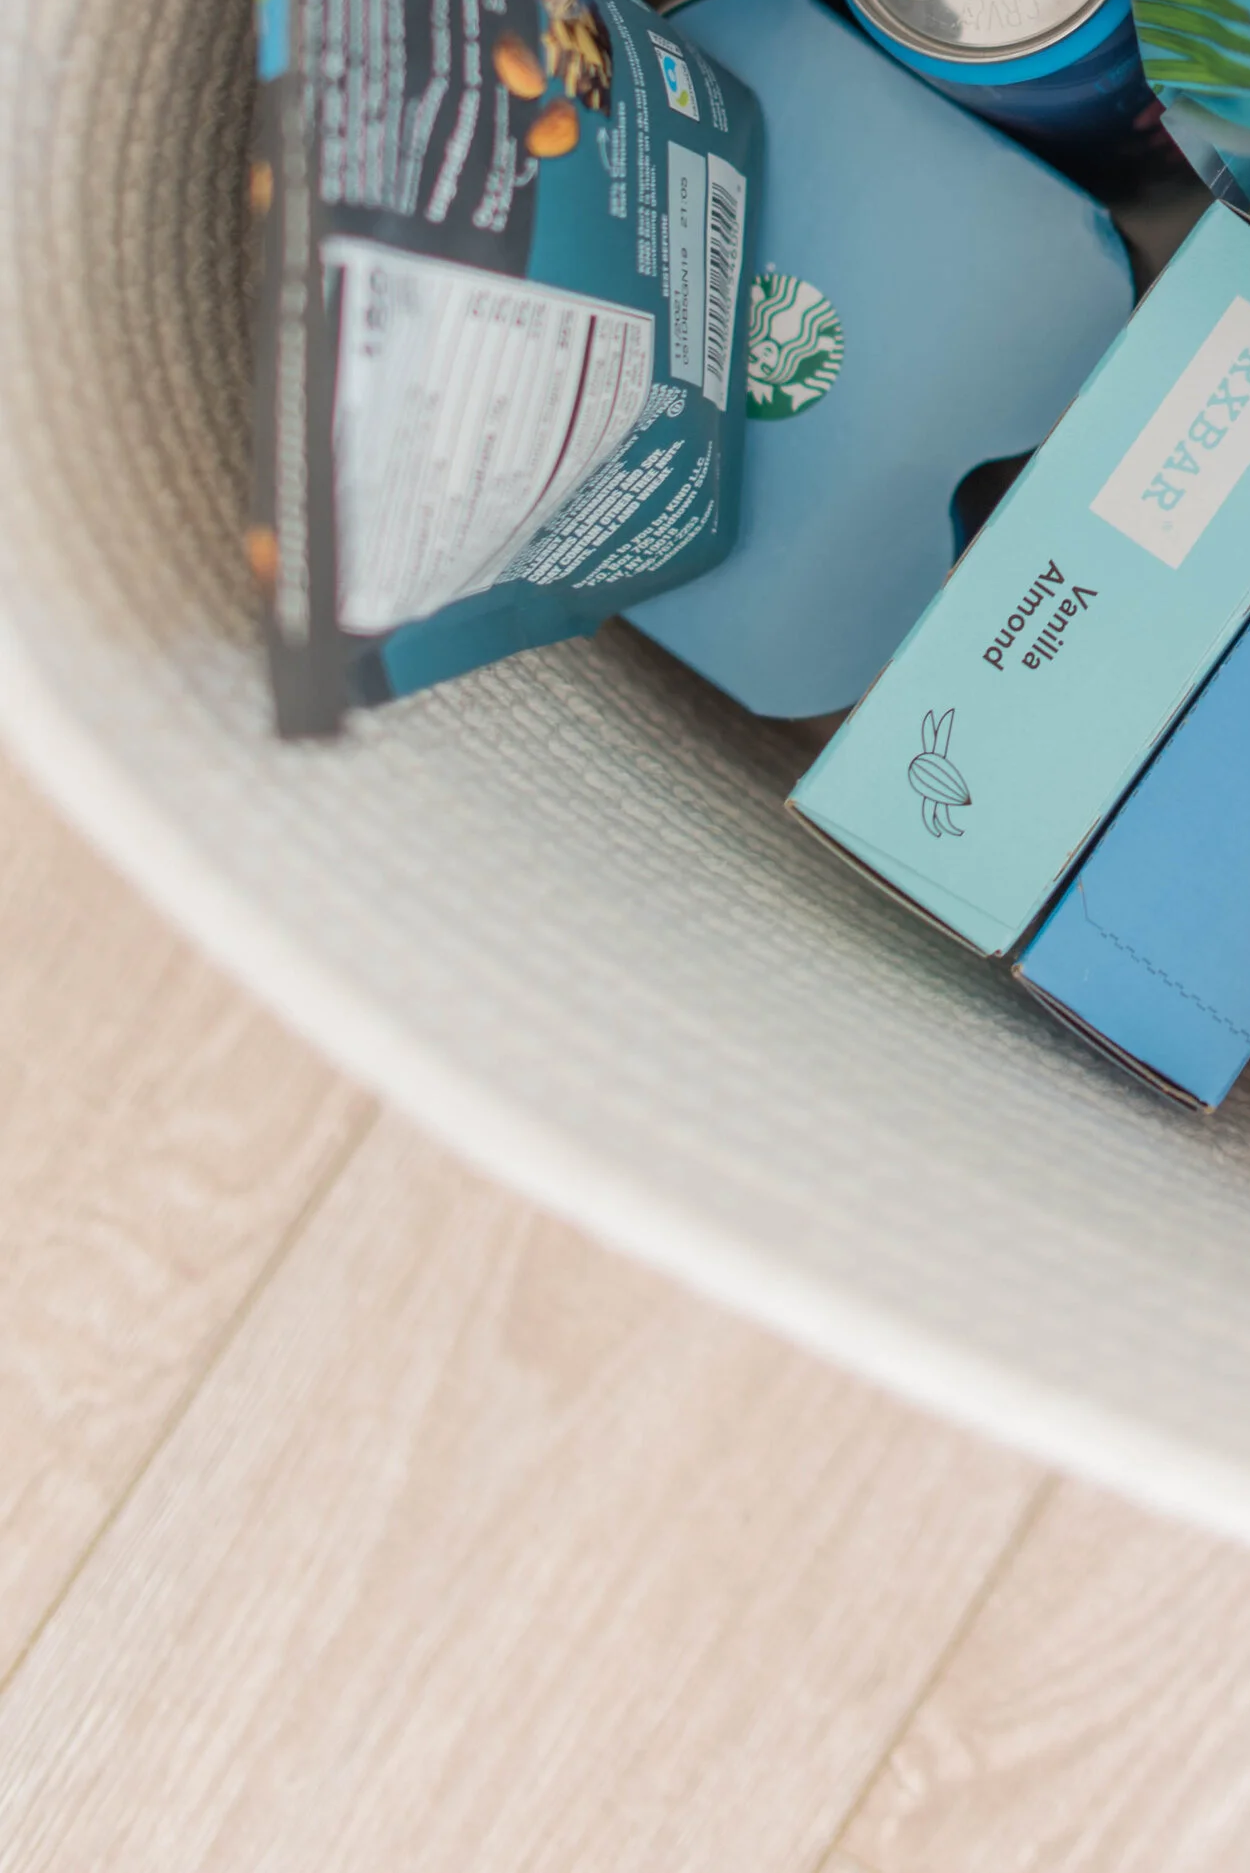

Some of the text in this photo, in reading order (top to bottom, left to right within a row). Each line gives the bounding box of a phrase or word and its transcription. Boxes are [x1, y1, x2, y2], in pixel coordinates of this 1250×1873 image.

[559, 523, 603, 566] CONTAIN
[599, 491, 634, 526] OTHER
[631, 466, 658, 494] TREE
[573, 487, 623, 537] ALMONDS
[620, 467, 643, 490] AND
[615, 499, 640, 523] AND
[653, 491, 698, 539] Midtown
[665, 483, 691, 513] KIND
[982, 559, 1065, 671] Almond
[1021, 584, 1098, 670] Vanilla
